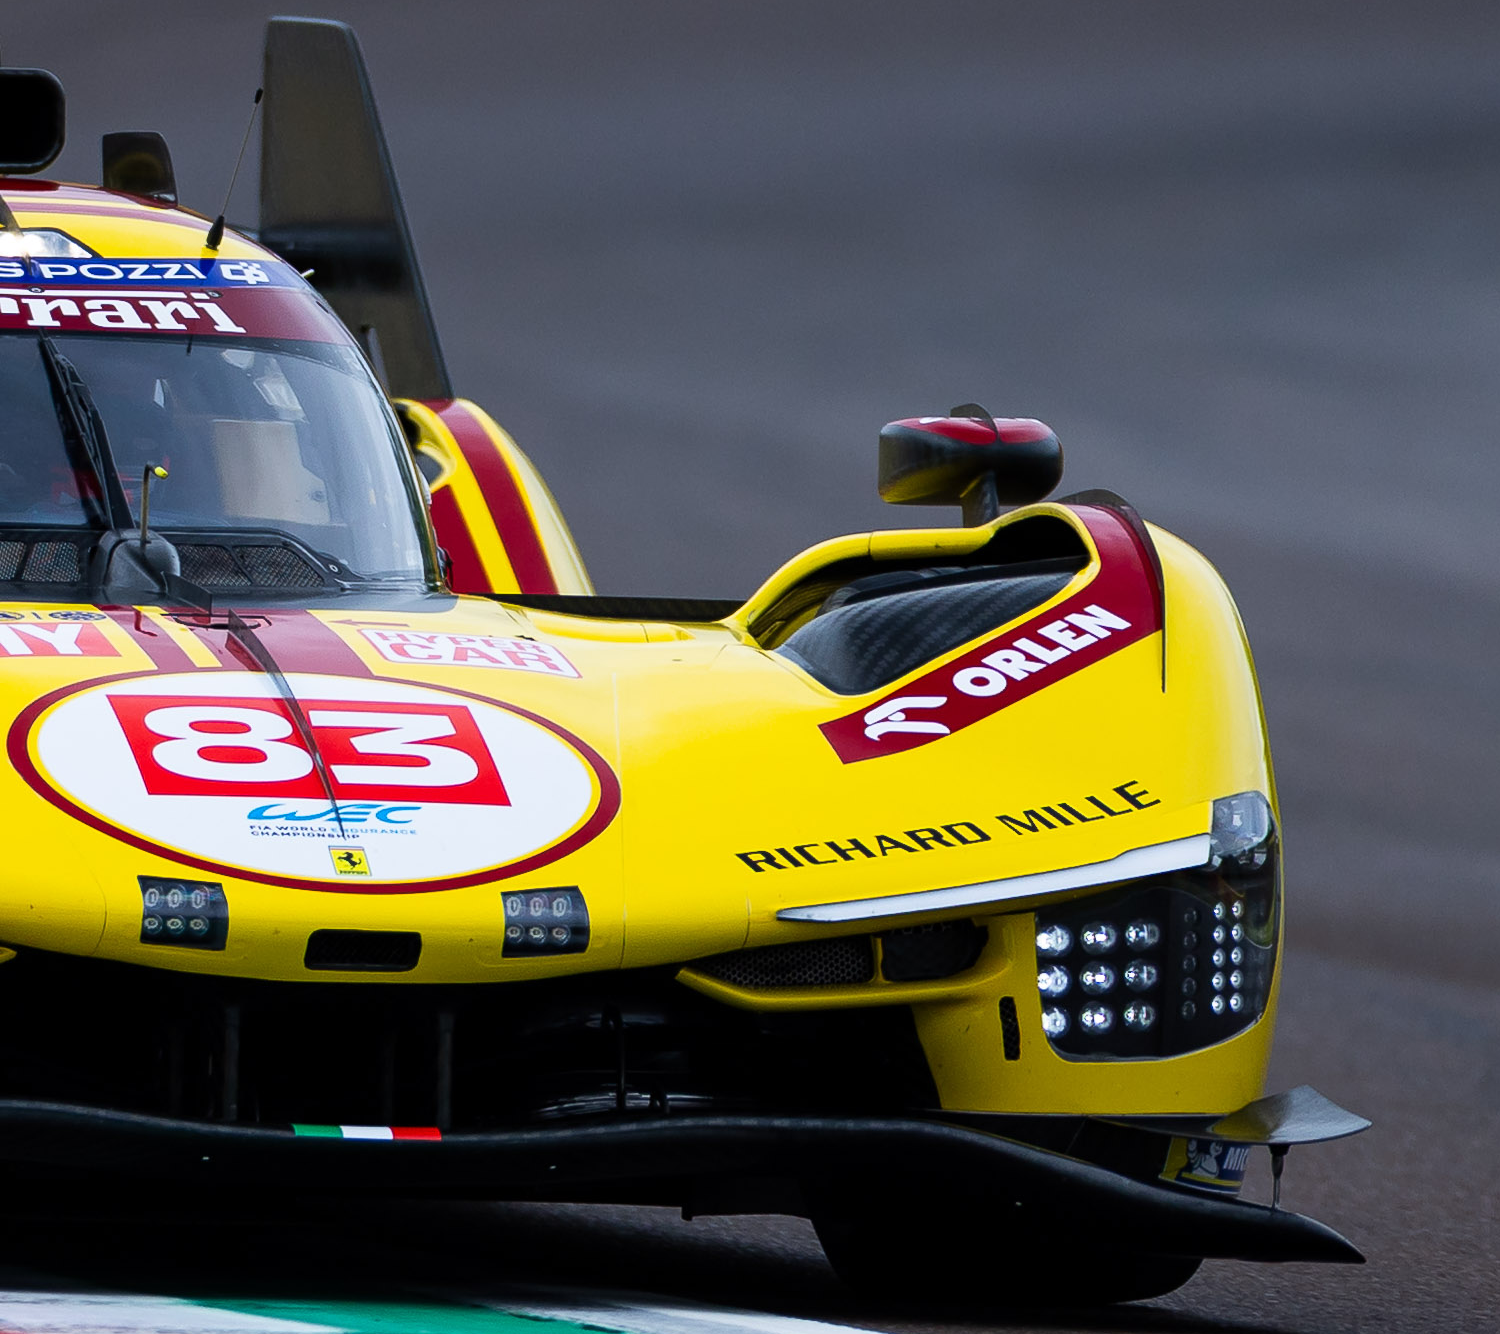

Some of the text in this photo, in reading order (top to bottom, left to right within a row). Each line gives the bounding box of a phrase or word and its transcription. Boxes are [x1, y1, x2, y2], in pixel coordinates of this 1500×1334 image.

[41, 263, 206, 281] POZZI
[374, 632, 547, 654] HYPER
[952, 603, 1132, 698] ORLEN
[389, 642, 564, 672] CAR
[144, 705, 479, 787] 83
[247, 803, 423, 824] WEC
[735, 780, 1162, 873] RICHARD MILLE
[276, 825, 327, 833] WORLD
